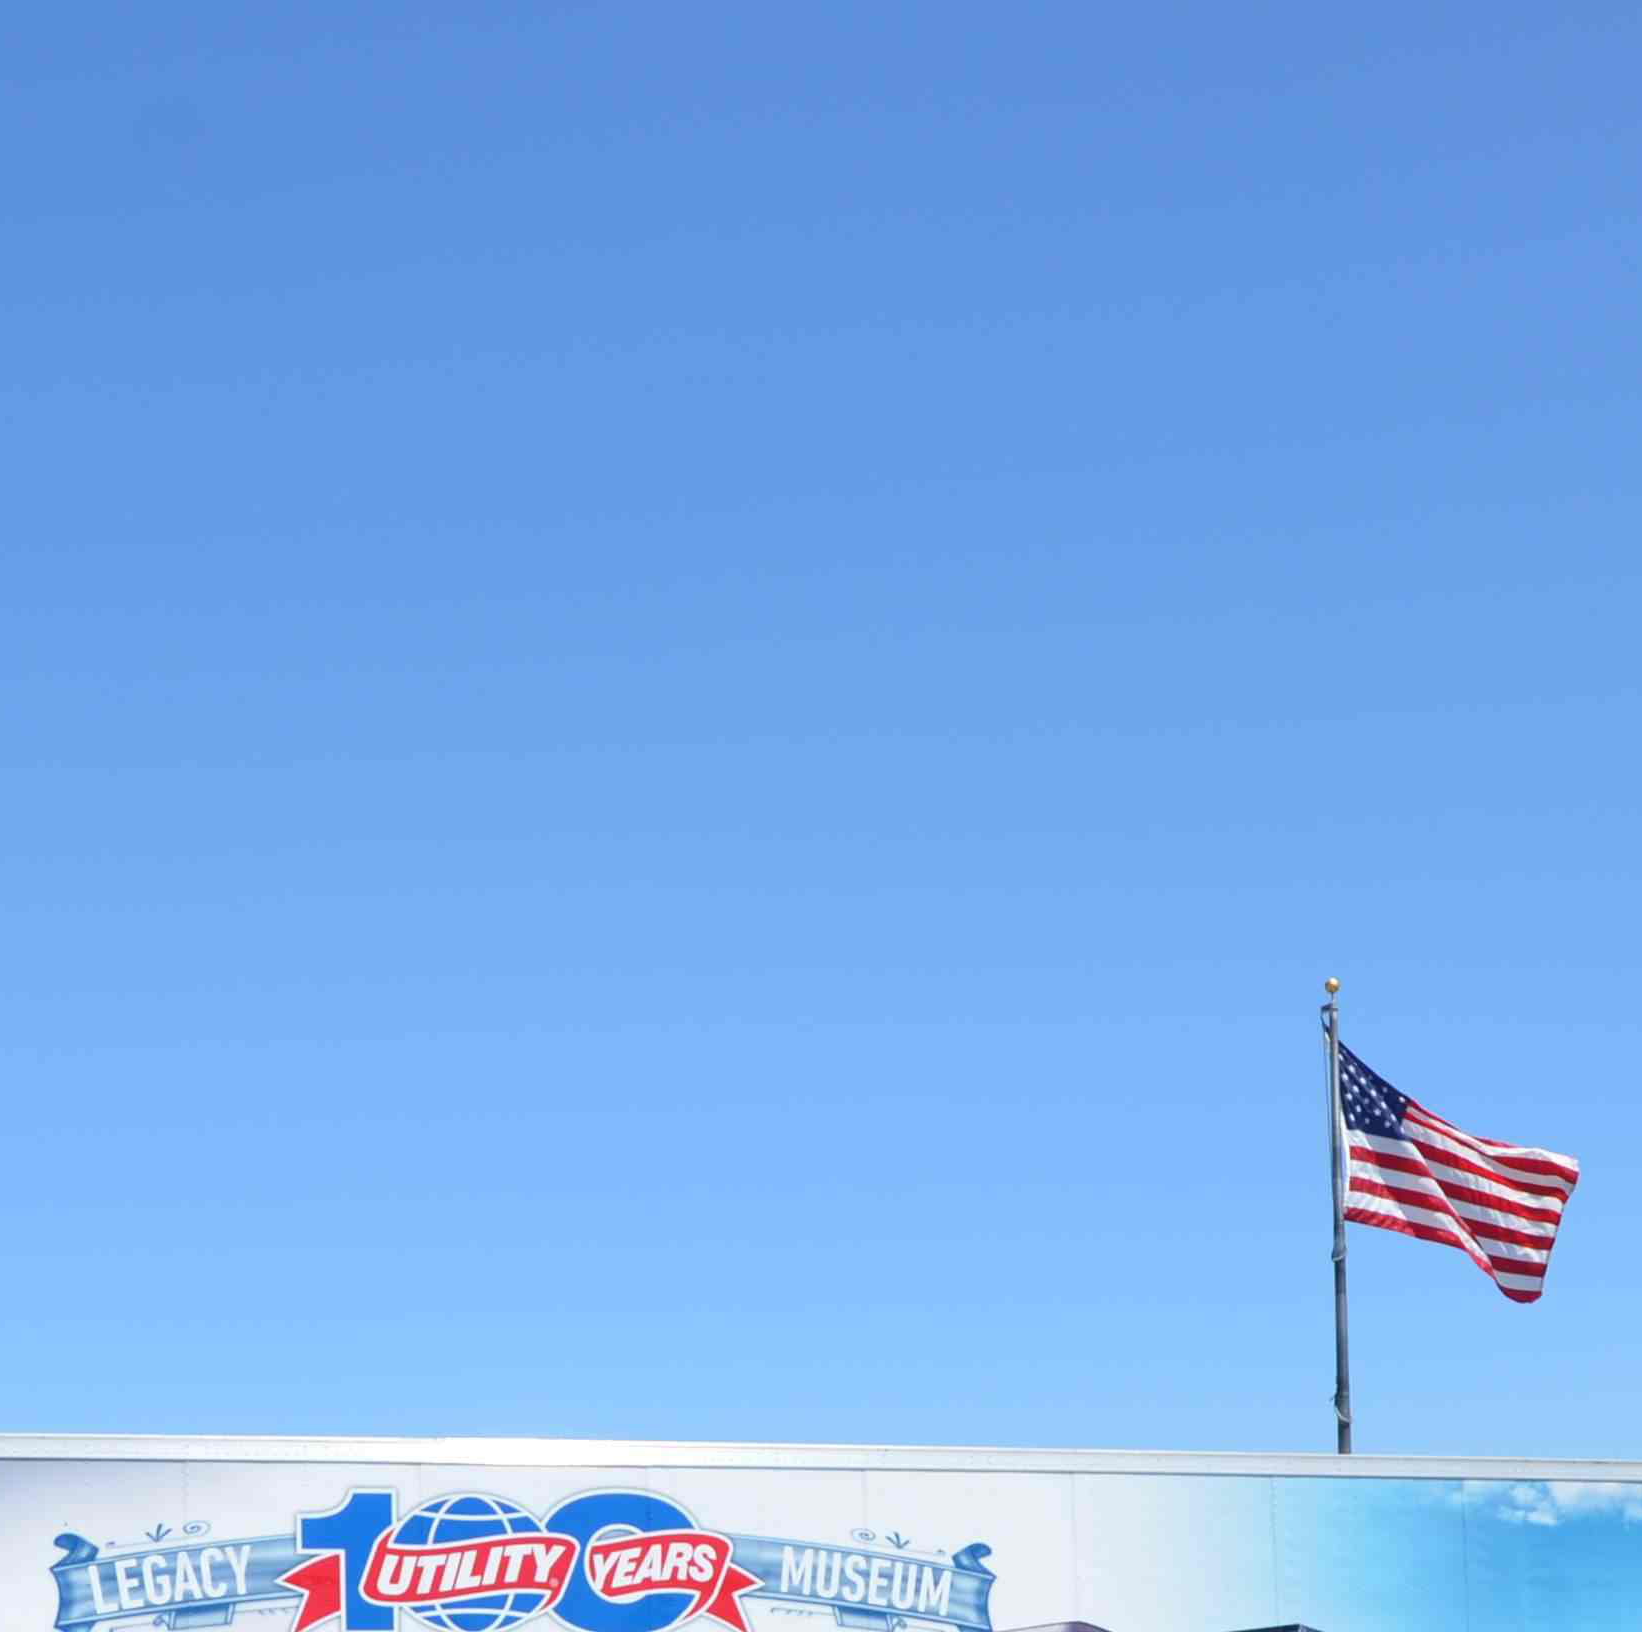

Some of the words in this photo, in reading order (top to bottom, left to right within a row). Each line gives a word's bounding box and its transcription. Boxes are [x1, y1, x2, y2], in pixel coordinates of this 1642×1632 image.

[88, 1544, 251, 1615] LEGACY
[376, 1543, 566, 1597] UTILITY
[592, 1543, 717, 1590] YEARS
[780, 1545, 953, 1616] MUSEUM
